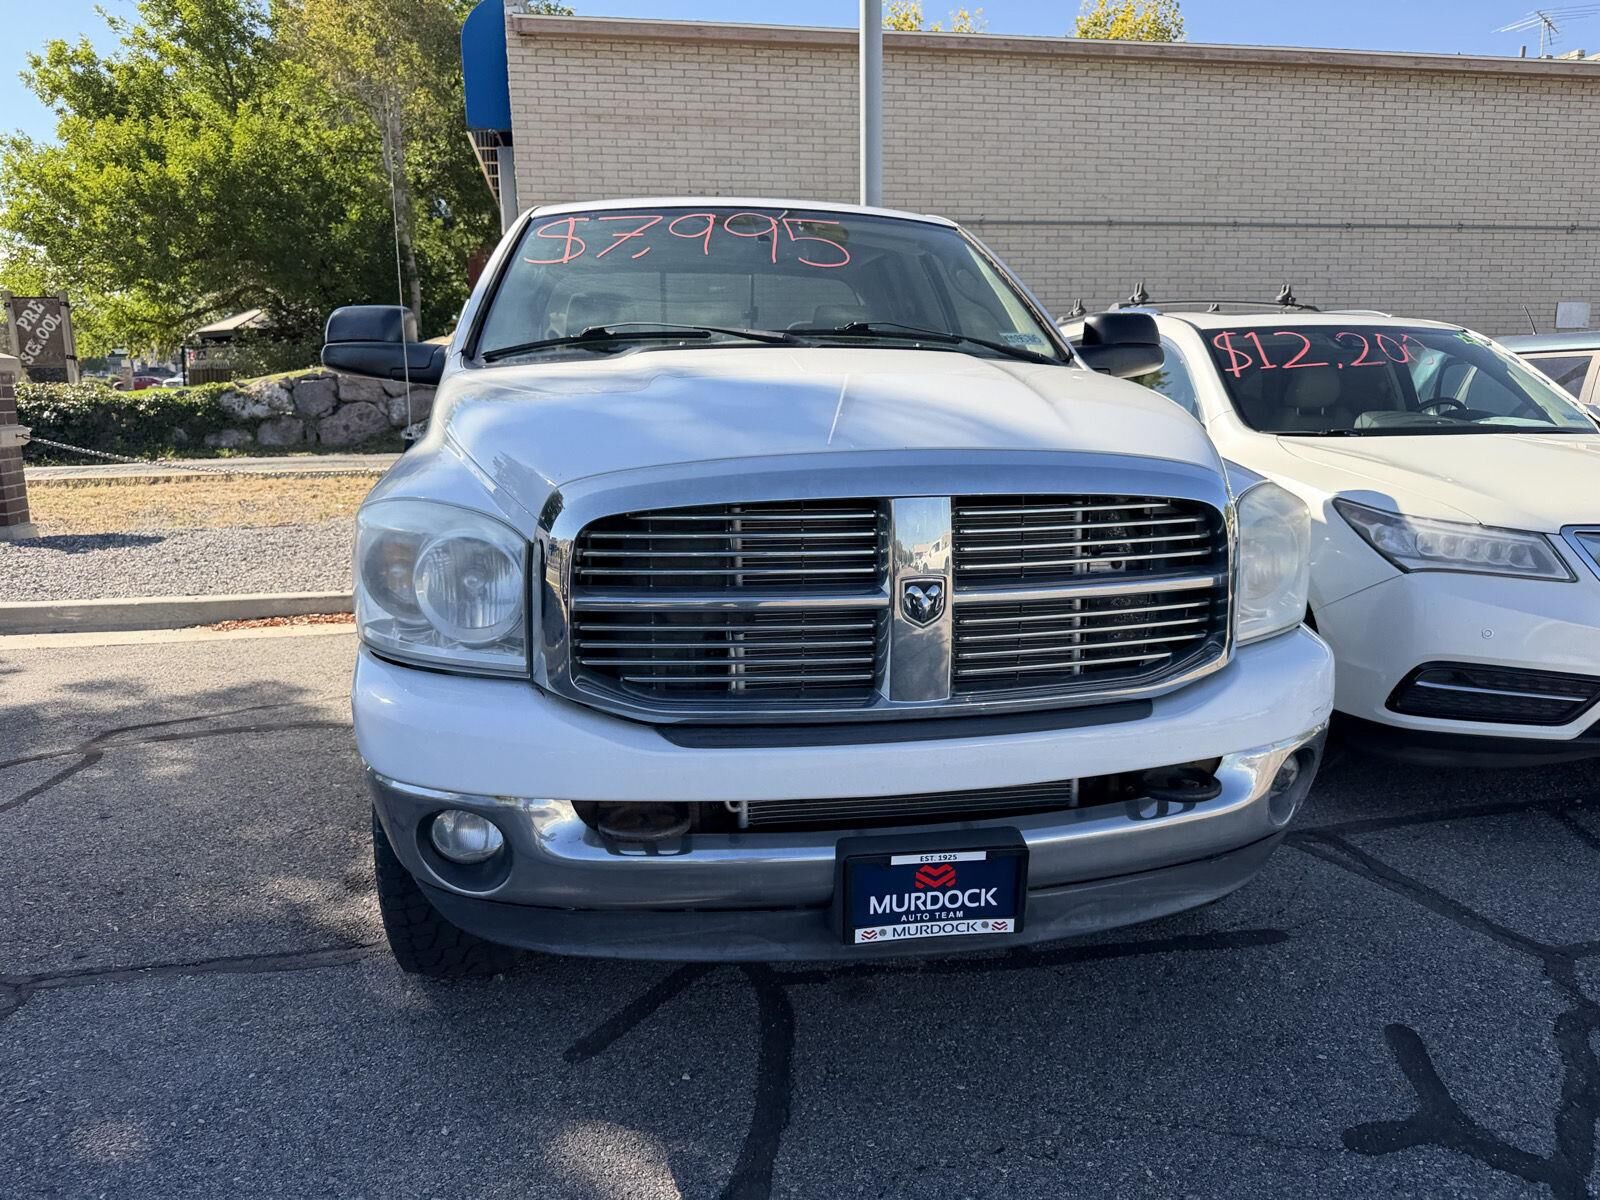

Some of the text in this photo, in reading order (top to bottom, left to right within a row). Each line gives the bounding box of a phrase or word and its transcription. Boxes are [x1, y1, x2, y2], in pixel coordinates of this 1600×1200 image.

[523, 212, 851, 268] $7,995
[16, 299, 46, 332] PRE
[920, 853, 958, 863] EST. 1925
[869, 887, 998, 915] MURDOCK
[900, 910, 964, 922] AUTO TEAM
[892, 921, 978, 938] MURDOCK
